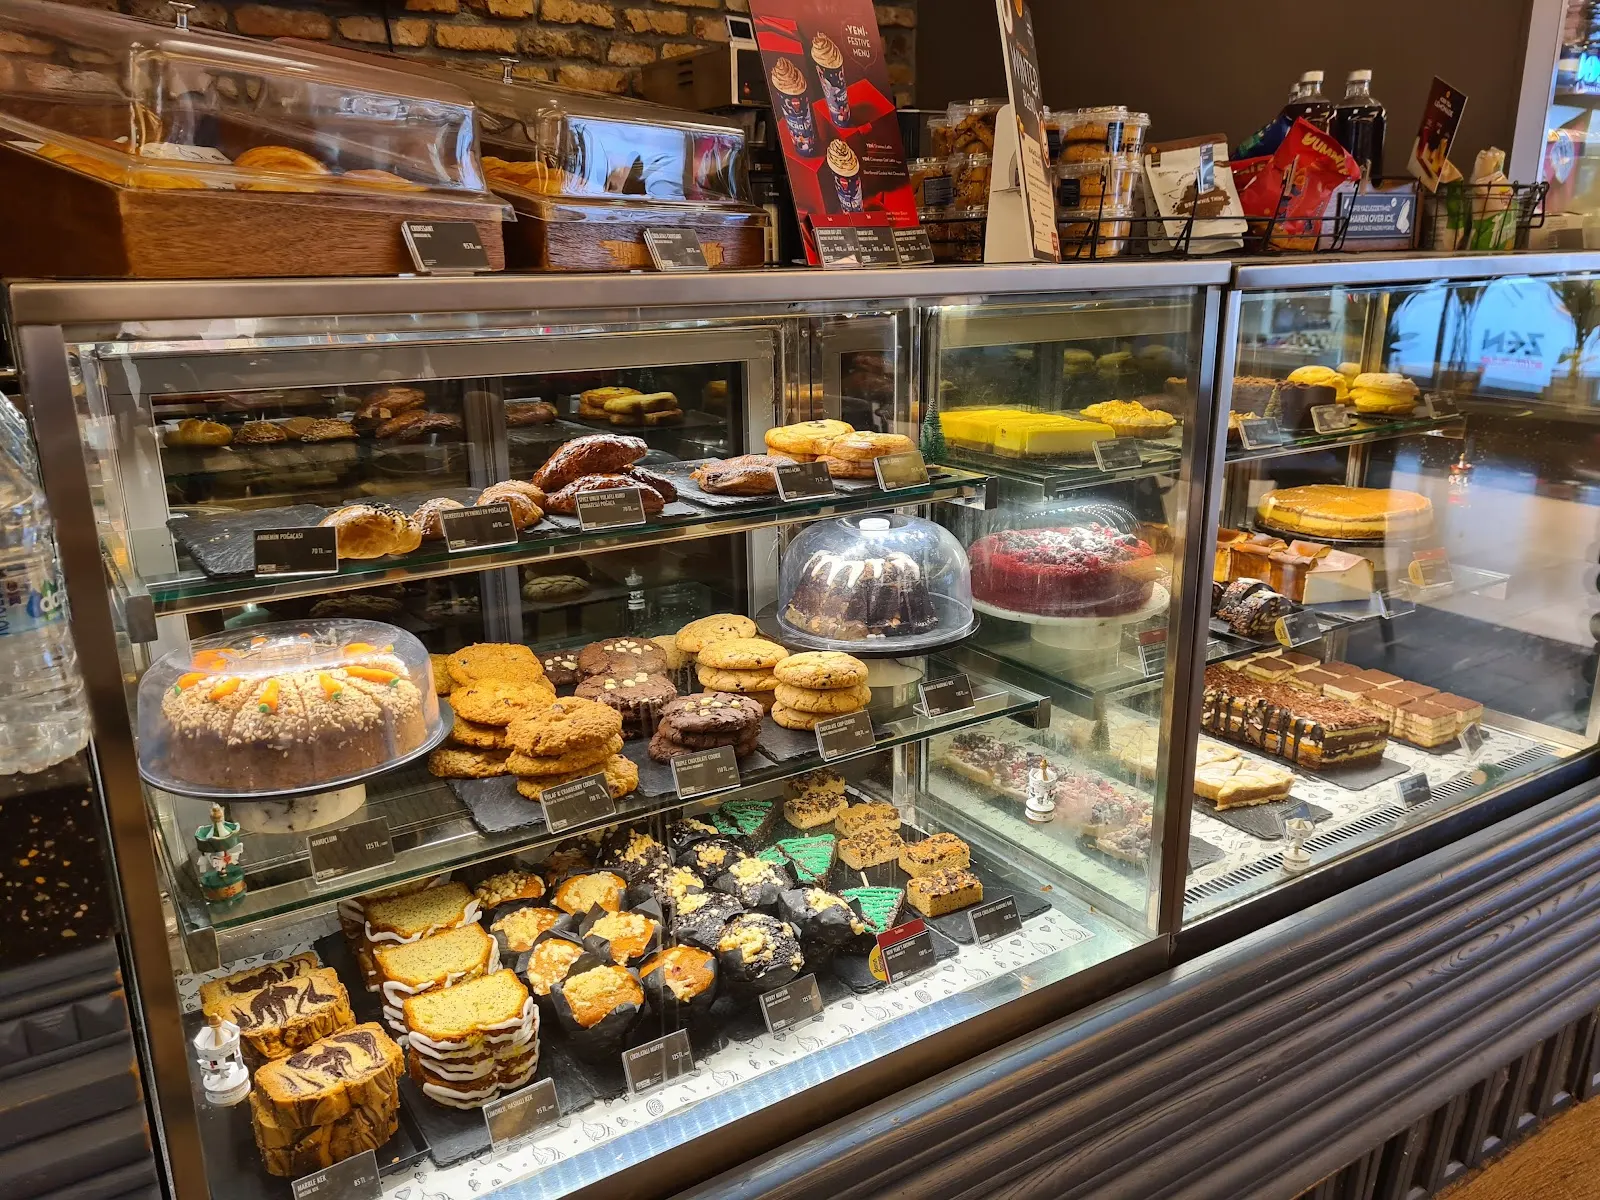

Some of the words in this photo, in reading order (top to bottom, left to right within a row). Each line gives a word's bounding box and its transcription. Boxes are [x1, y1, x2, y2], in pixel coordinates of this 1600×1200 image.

[848, 36, 871, 48] FESTIVE
[1010, 42, 1040, 99] WINTER
[1022, 88, 1036, 115] BLEND
[1347, 214, 1369, 222] HAKEN
[1385, 214, 1394, 222] ICE
[280, 532, 304, 540] POĞAÇASI
[688, 756, 708, 764] CHOCOLATE
[561, 784, 583, 795] CRANBERRY
[583, 779, 596, 788] COOKIE
[312, 835, 338, 847] HAVUÇLUM
[525, 1094, 534, 1102] KEK
[297, 1179, 316, 1192] MARBLE
[316, 1175, 327, 1184] KEK
